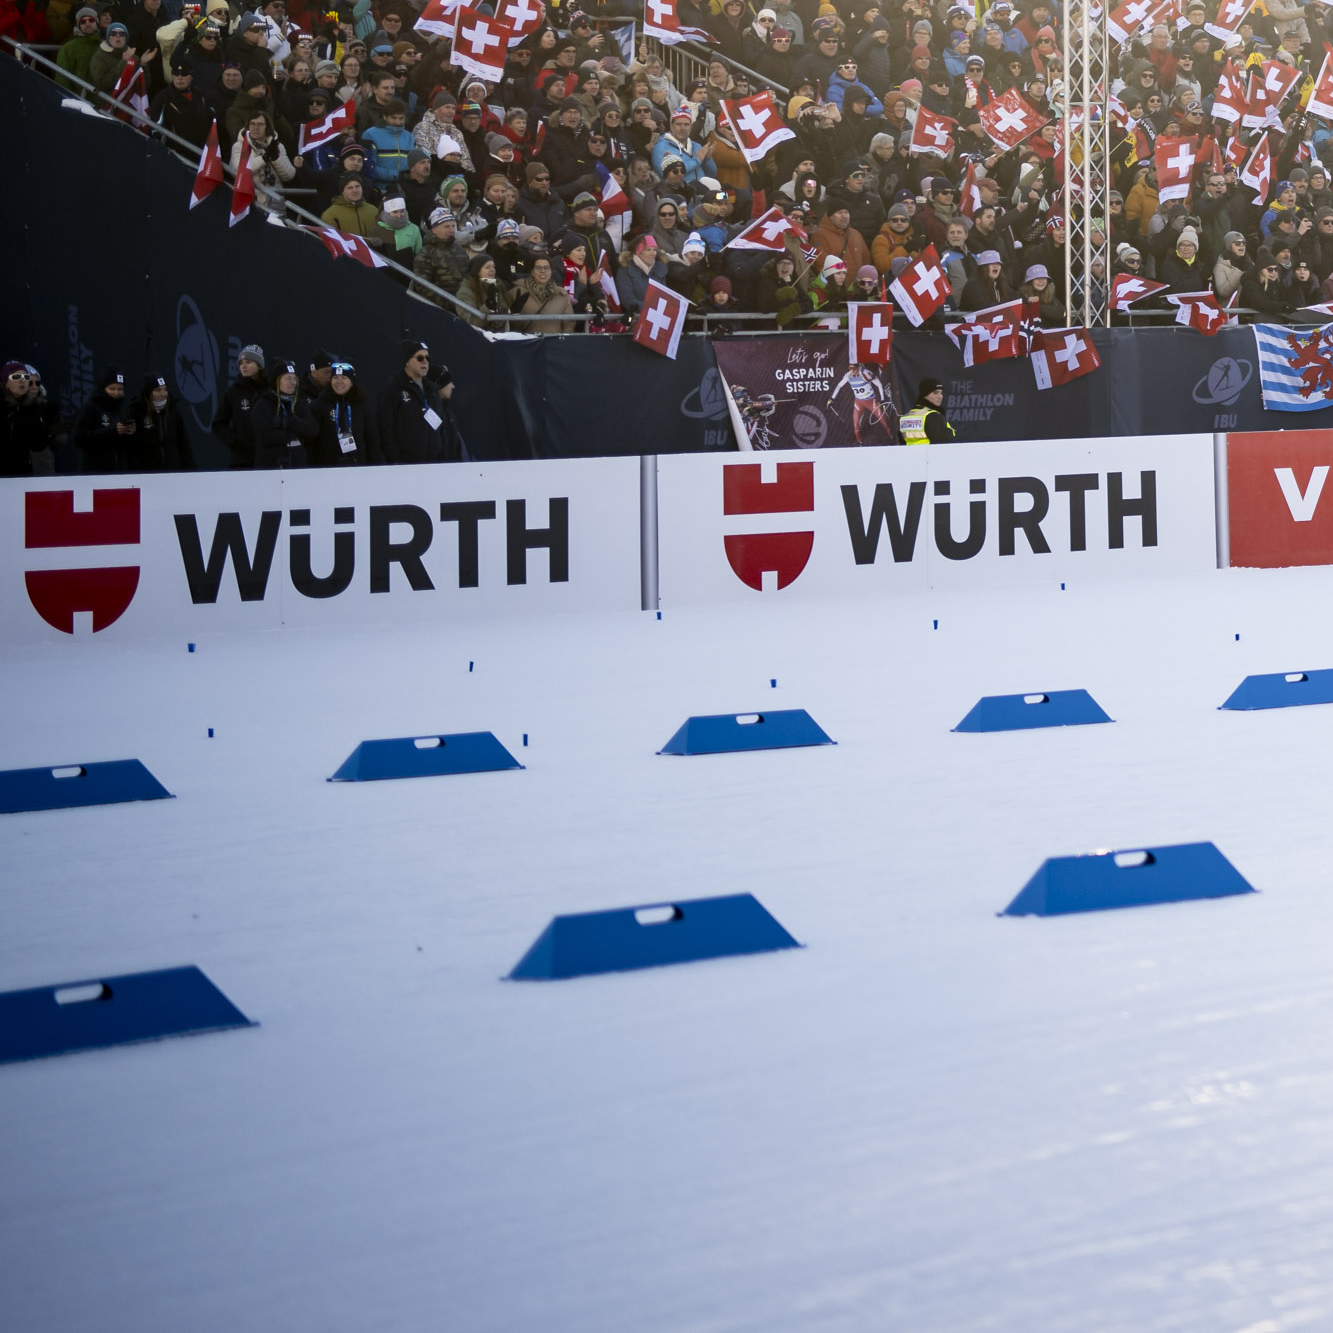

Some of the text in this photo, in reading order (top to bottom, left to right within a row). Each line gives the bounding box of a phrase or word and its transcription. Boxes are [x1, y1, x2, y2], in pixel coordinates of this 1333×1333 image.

[775, 366, 835, 381] GASPARIN
[785, 380, 830, 393] SISTERS
[952, 380, 974, 394] THE
[947, 393, 1015, 408] BIATHLON
[946, 407, 995, 422] FAMILY
[1213, 414, 1238, 429] IBU
[704, 429, 728, 446] IBU
[840, 470, 1158, 565] WÜRTH
[174, 497, 570, 604] WÜRTH
